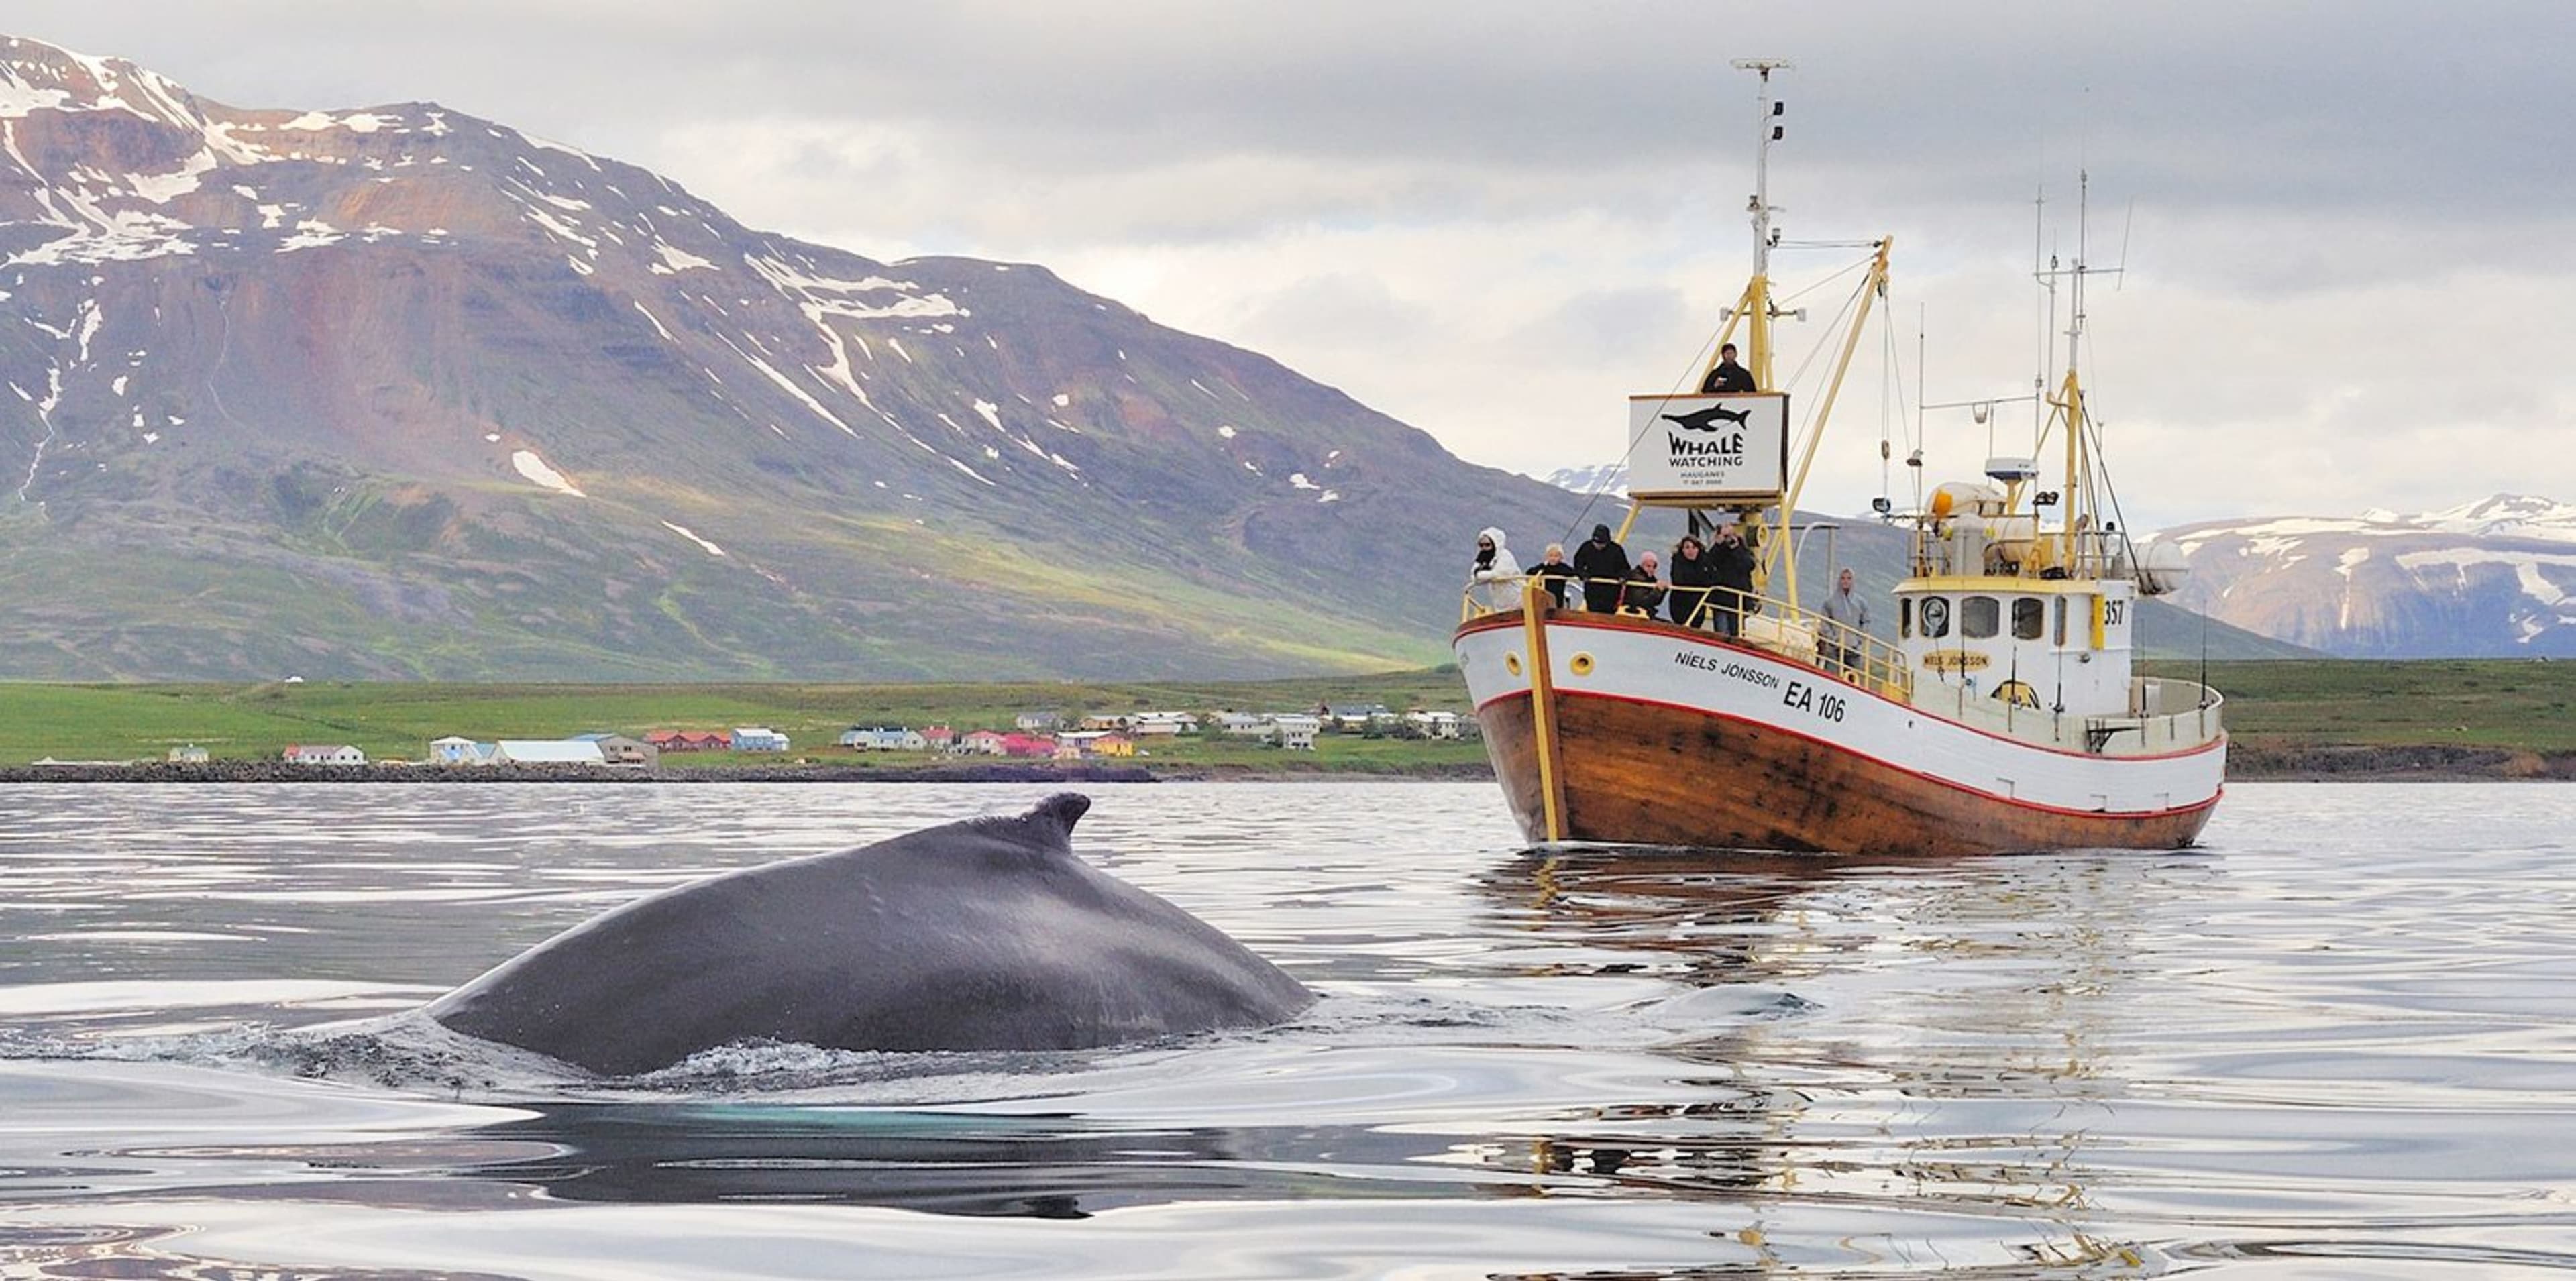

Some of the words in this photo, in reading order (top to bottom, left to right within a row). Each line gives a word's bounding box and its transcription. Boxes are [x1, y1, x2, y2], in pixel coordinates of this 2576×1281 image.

[1668, 431, 1743, 455] WHALE
[1669, 457, 1743, 467] WATCHING
[2104, 600, 2124, 625] 357
[1783, 681, 1812, 712] EA
[1818, 693, 1846, 722] 106
